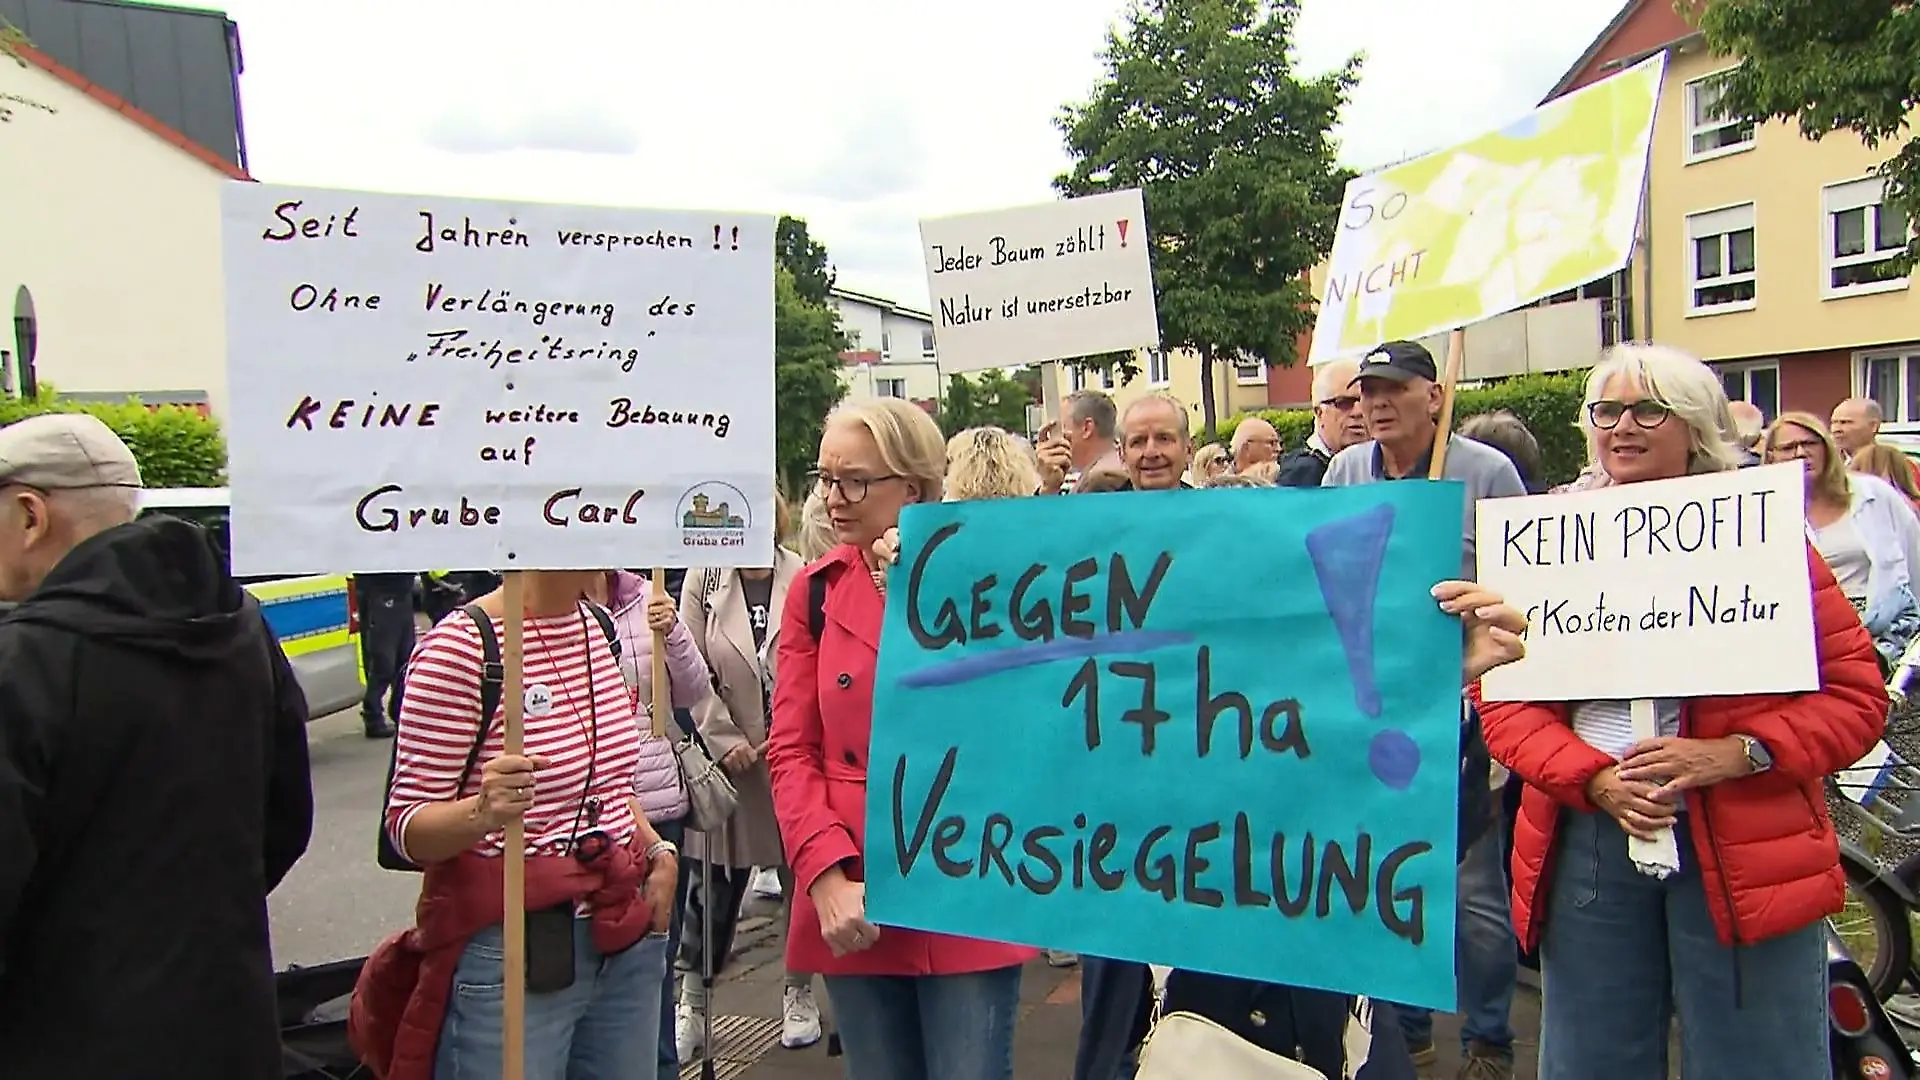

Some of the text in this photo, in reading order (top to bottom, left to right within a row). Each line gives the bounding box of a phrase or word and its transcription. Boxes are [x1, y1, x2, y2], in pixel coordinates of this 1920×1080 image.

[262, 199, 740, 253] Seit Jahren versprochen !!
[1344, 188, 1408, 231] SO
[931, 244, 983, 274] Jeder
[988, 236, 1045, 266] Baum
[1055, 224, 1105, 257] zählt
[1326, 249, 1427, 306] NICHT
[290, 283, 696, 326] Ohne Verlängerung des
[939, 281, 1132, 328] Natur ist unersetzbar
[485, 403, 579, 424] weitere
[605, 398, 731, 439] Bebauung
[480, 437, 536, 466] auf
[355, 484, 645, 533] Grube Carl
[1503, 489, 1776, 567] KEIN PROFIT
[906, 522, 1173, 651] GEGEN
[1542, 591, 1631, 637] Kosten
[1639, 595, 1682, 631] der
[1688, 583, 1780, 627] Natur
[1062, 645, 1311, 761] 17 ha
